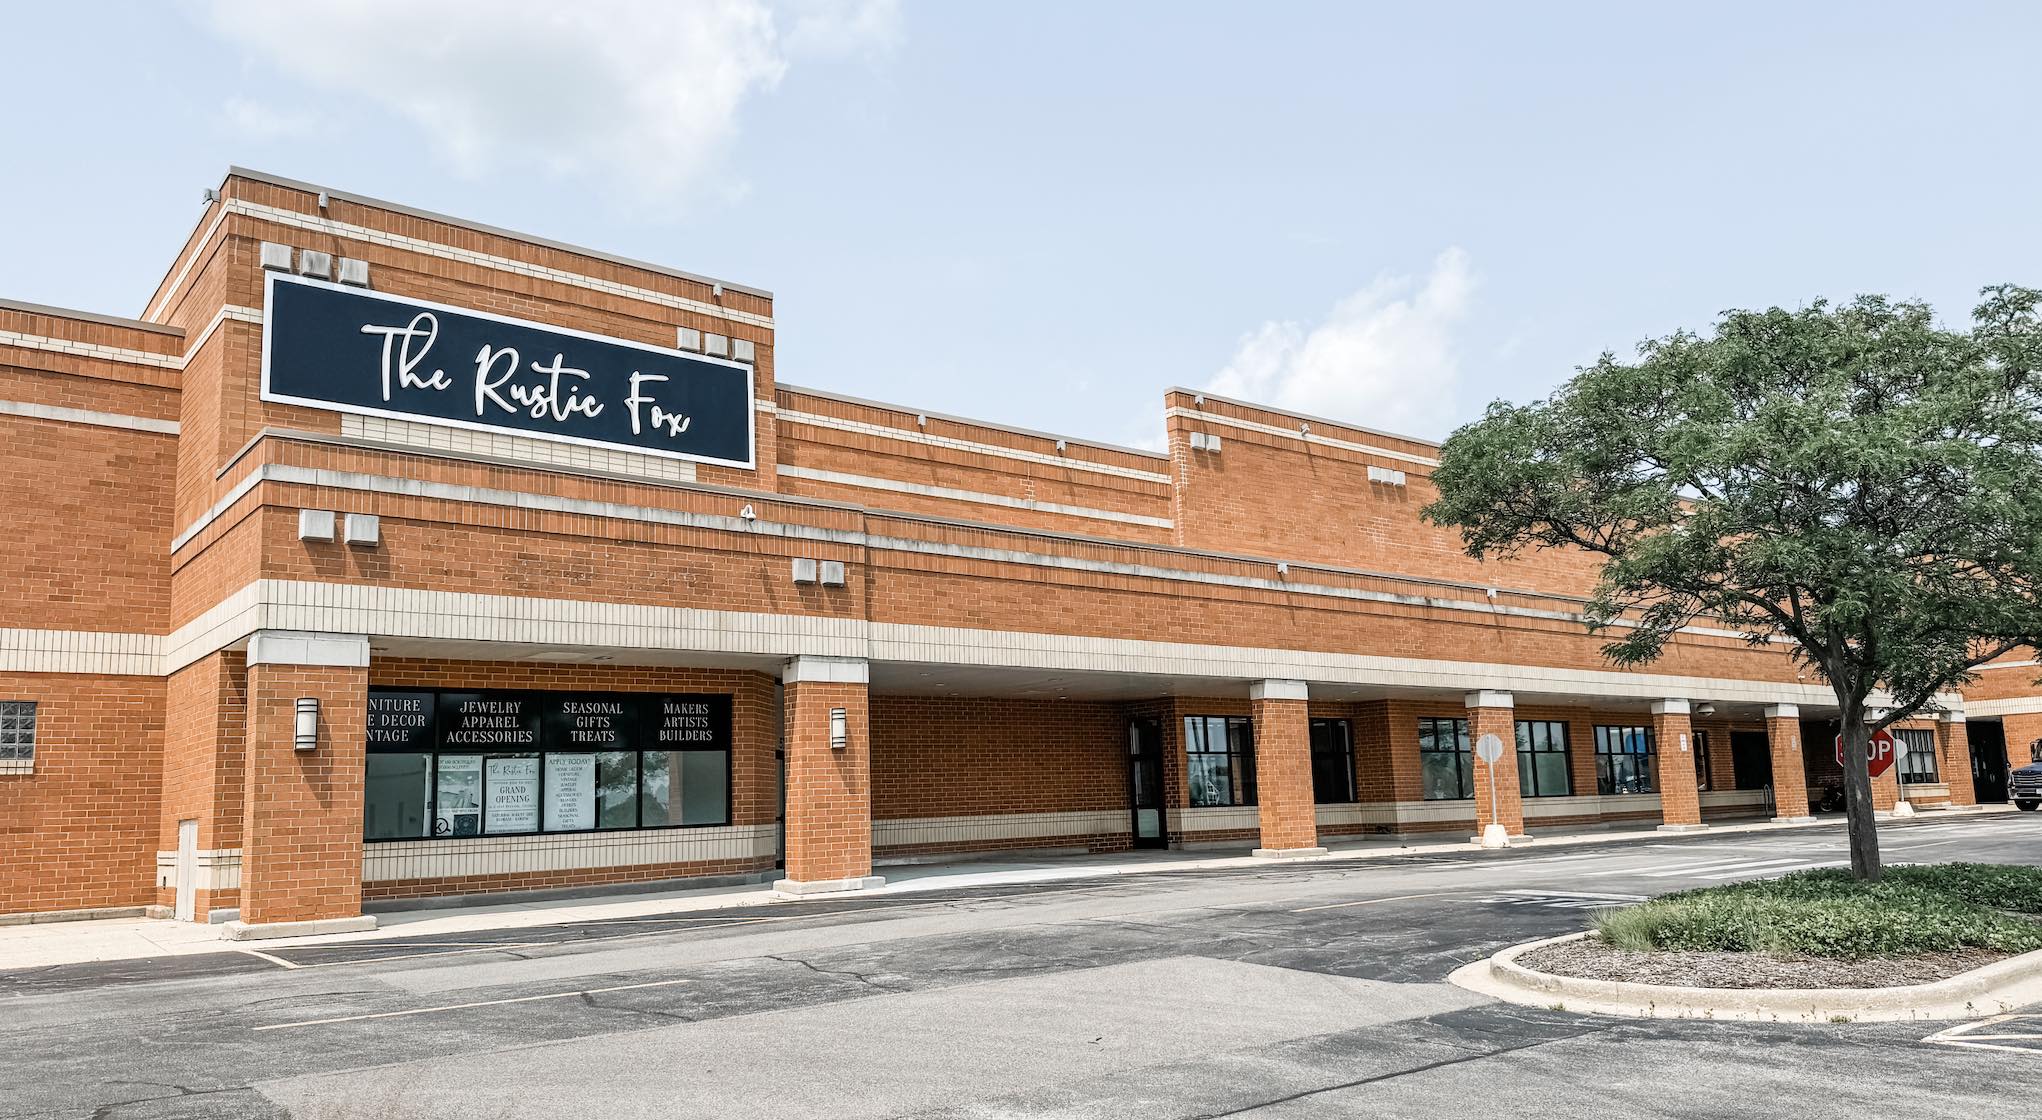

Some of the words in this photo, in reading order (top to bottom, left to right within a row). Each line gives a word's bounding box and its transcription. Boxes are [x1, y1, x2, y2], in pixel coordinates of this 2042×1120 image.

[361, 312, 452, 402] The
[475, 344, 605, 422] Rustic
[624, 371, 691, 437] Fox
[369, 698, 420, 711] NITURE
[460, 701, 521, 713] JEWELRY
[563, 702, 623, 714] SEASONAL
[664, 703, 709, 714] MAKERS
[382, 714, 426, 727] DECOR
[461, 716, 520, 728] APPAREL
[576, 716, 610, 728] GIFTS
[664, 716, 708, 728] ARTISTS
[367, 729, 409, 742] NTAGE
[446, 731, 533, 743] ACCESSORIES
[570, 730, 615, 742] TREATS
[660, 729, 713, 741] BUILDERS
[499, 786, 527, 794] GRAND
[495, 795, 530, 803] OPENING
